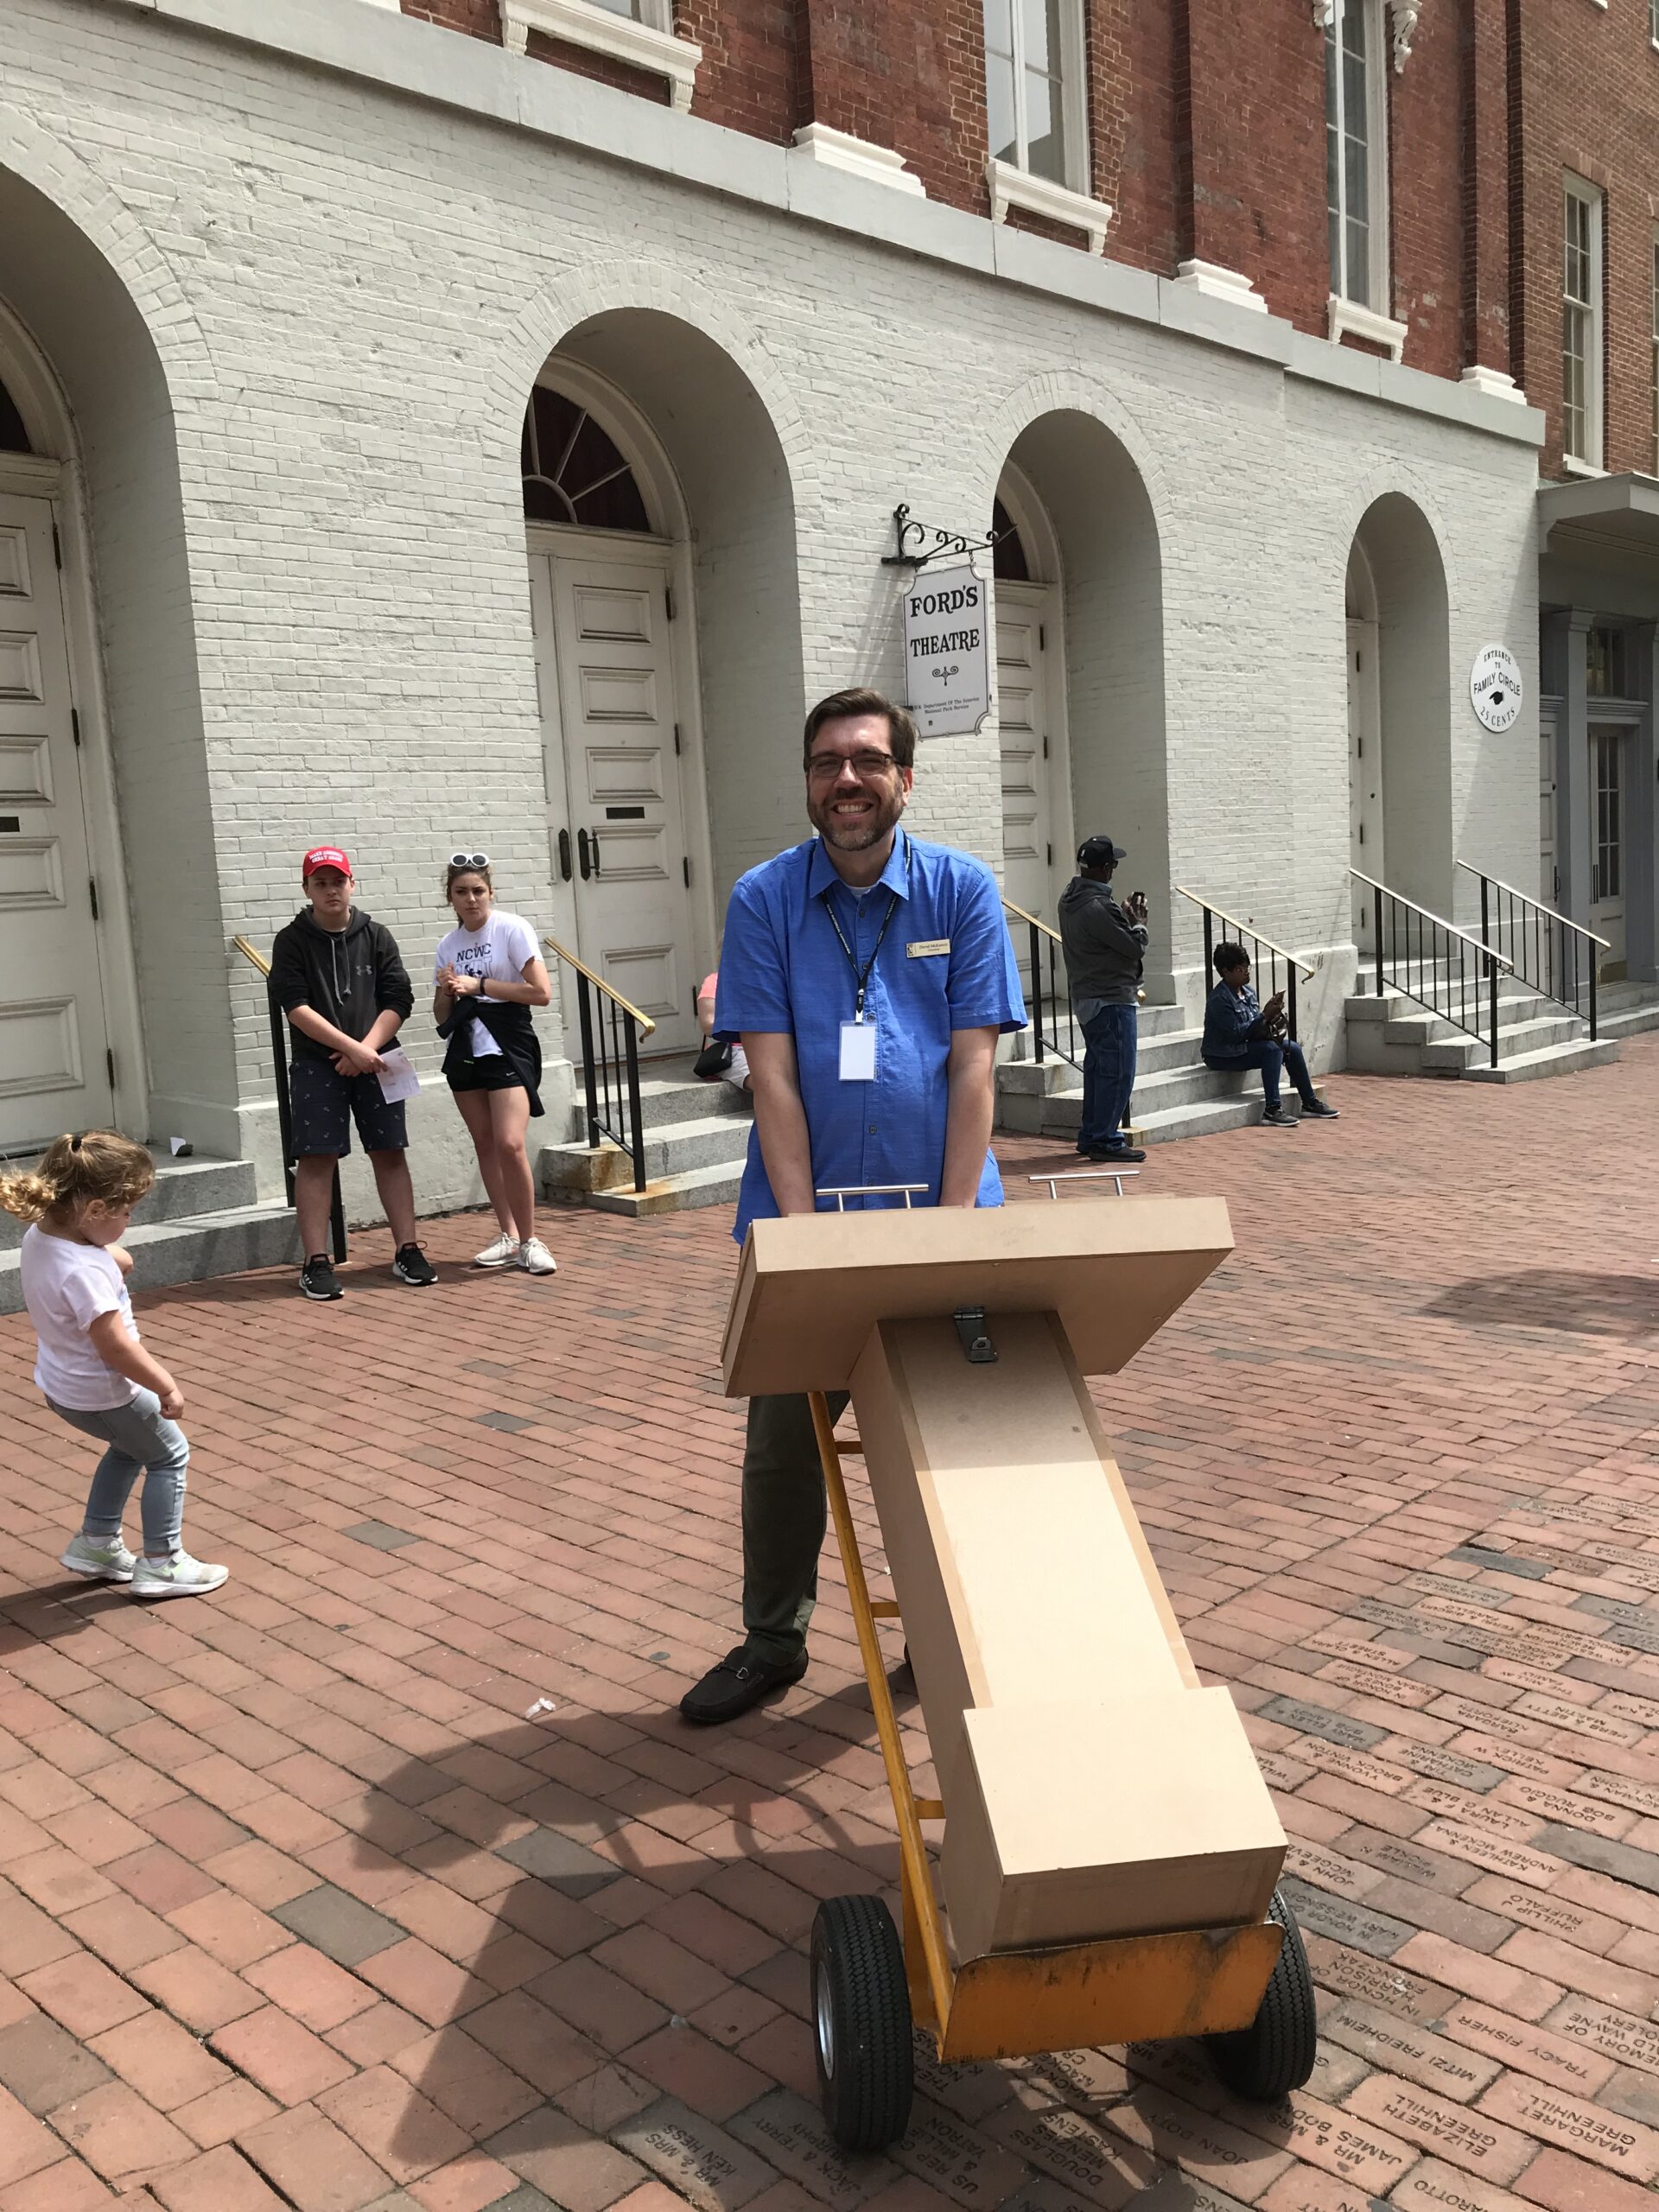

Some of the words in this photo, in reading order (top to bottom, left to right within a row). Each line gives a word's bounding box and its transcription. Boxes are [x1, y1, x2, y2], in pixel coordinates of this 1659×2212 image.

[910, 585, 978, 617] FORD'S
[910, 628, 980, 657] THEATRE
[1484, 650, 1512, 665] ENTRANCE
[1473, 672, 1497, 695] FAMILY
[1498, 672, 1521, 696] CIRCLE
[1480, 706, 1490, 721] 25
[1491, 707, 1516, 727] CENTS
[456, 943, 492, 963] NCWC
[1312, 1640, 1348, 1652] CLARA
[1466, 1631, 1514, 1645] DISTRICT
[1536, 1628, 1583, 1642] DISTRICT
[1519, 1643, 1563, 1659] SCHOOL
[1588, 1640, 1631, 1656] SCHOOL
[1363, 1654, 1402, 1667] ALLEN
[1396, 1681, 1433, 1696] SUSAN
[1520, 1671, 1564, 1687] FAMILY
[1548, 1686, 1573, 1696] THE
[1288, 1713, 1328, 1729] ELLEN
[1457, 1710, 1519, 1734] BARBARA
[1523, 1704, 1569, 1720] BETTY
[1554, 1706, 1606, 1726] MARTIN
[1332, 1728, 1366, 1744] MARY
[1335, 1722, 1364, 1735] BOB
[1589, 1724, 1629, 1739] HERB
[1304, 1742, 1351, 1763] VINTON
[1397, 1748, 1473, 1777] CATHARINE
[1410, 1745, 1478, 1770] MCKENNA
[1492, 1752, 1550, 1776] PATRICK
[1493, 1745, 1545, 1766] KELLEY
[1325, 1758, 1379, 1781] YVONNE
[1357, 1760, 1403, 1782] BROCK
[1590, 1776, 1629, 1789] JOHN
[1421, 1787, 1460, 1802] BLUE
[1520, 1786, 1577, 1809] RUGGIO
[1460, 1808, 1510, 1830] LAURA
[1482, 1808, 1531, 1828] ALLAN
[1542, 1801, 1596, 1823] DONNA
[1581, 1806, 1616, 1821] BOB
[1436, 1826, 1497, 1851] MCKENNA
[1460, 1844, 1529, 1872] KATHLEEN
[1499, 1849, 1558, 1873] ANDREW
[1313, 1866, 1355, 1887] JOHN
[1510, 1895, 1584, 1926] RUFFALO
[1516, 1907, 1576, 1933] PHILLIP
[1361, 1921, 1399, 1939] MARY
[1310, 1964, 1332, 1977] OF
[1329, 1961, 1415, 2003] HARRISON
[1337, 1952, 1427, 1995] FRONCZAK
[1336, 1975, 1397, 2005] HONOR
[1401, 2004, 1421, 2017] IN
[1337, 2015, 1425, 2058] FREIDHEIM
[1457, 2015, 1522, 2047] FISHER
[1561, 2024, 1588, 2037] OF
[1568, 2012, 1625, 2040] WAYNE
[1427, 2056, 1477, 2082] MITZI
[1527, 2047, 1588, 2079] TRACY
[1149, 2114, 1194, 2141] DOTY
[1267, 2113, 1308, 2136] MRS
[1382, 2104, 1488, 2158] ELIZABETH
[1395, 2094, 1497, 2146] GREENHILL
[1529, 2094, 1637, 2145] GREENHILL
[662, 2124, 705, 2154] HESS
[752, 2117, 799, 2153] TERRY
[787, 2122, 845, 2162] MURPHY
[907, 2127, 961, 2160] MILLIE
[925, 2117, 986, 2160] YATRON
[1039, 2113, 1122, 2160] KASTENS
[1315, 2135, 1329, 2146] &
[1516, 2107, 1630, 2157] MARGARET
[645, 2133, 681, 2158] MRS
[803, 2152, 817, 2162] &
[1033, 2125, 1108, 2171] MENZIES
[1197, 2139, 1249, 2165] JOAN
[1333, 2145, 1365, 2165] MR
[1336, 2130, 1402, 2165] JAMES
[680, 2156, 695, 2167] &
[701, 2151, 738, 2177] KEN
[915, 2152, 951, 2176] REP
[963, 2160, 978, 2172] &
[1009, 2129, 1104, 2186] DOUGLASS
[694, 2167, 721, 2188] MR
[817, 2162, 861, 2192] JACK
[951, 2174, 979, 2195] US
